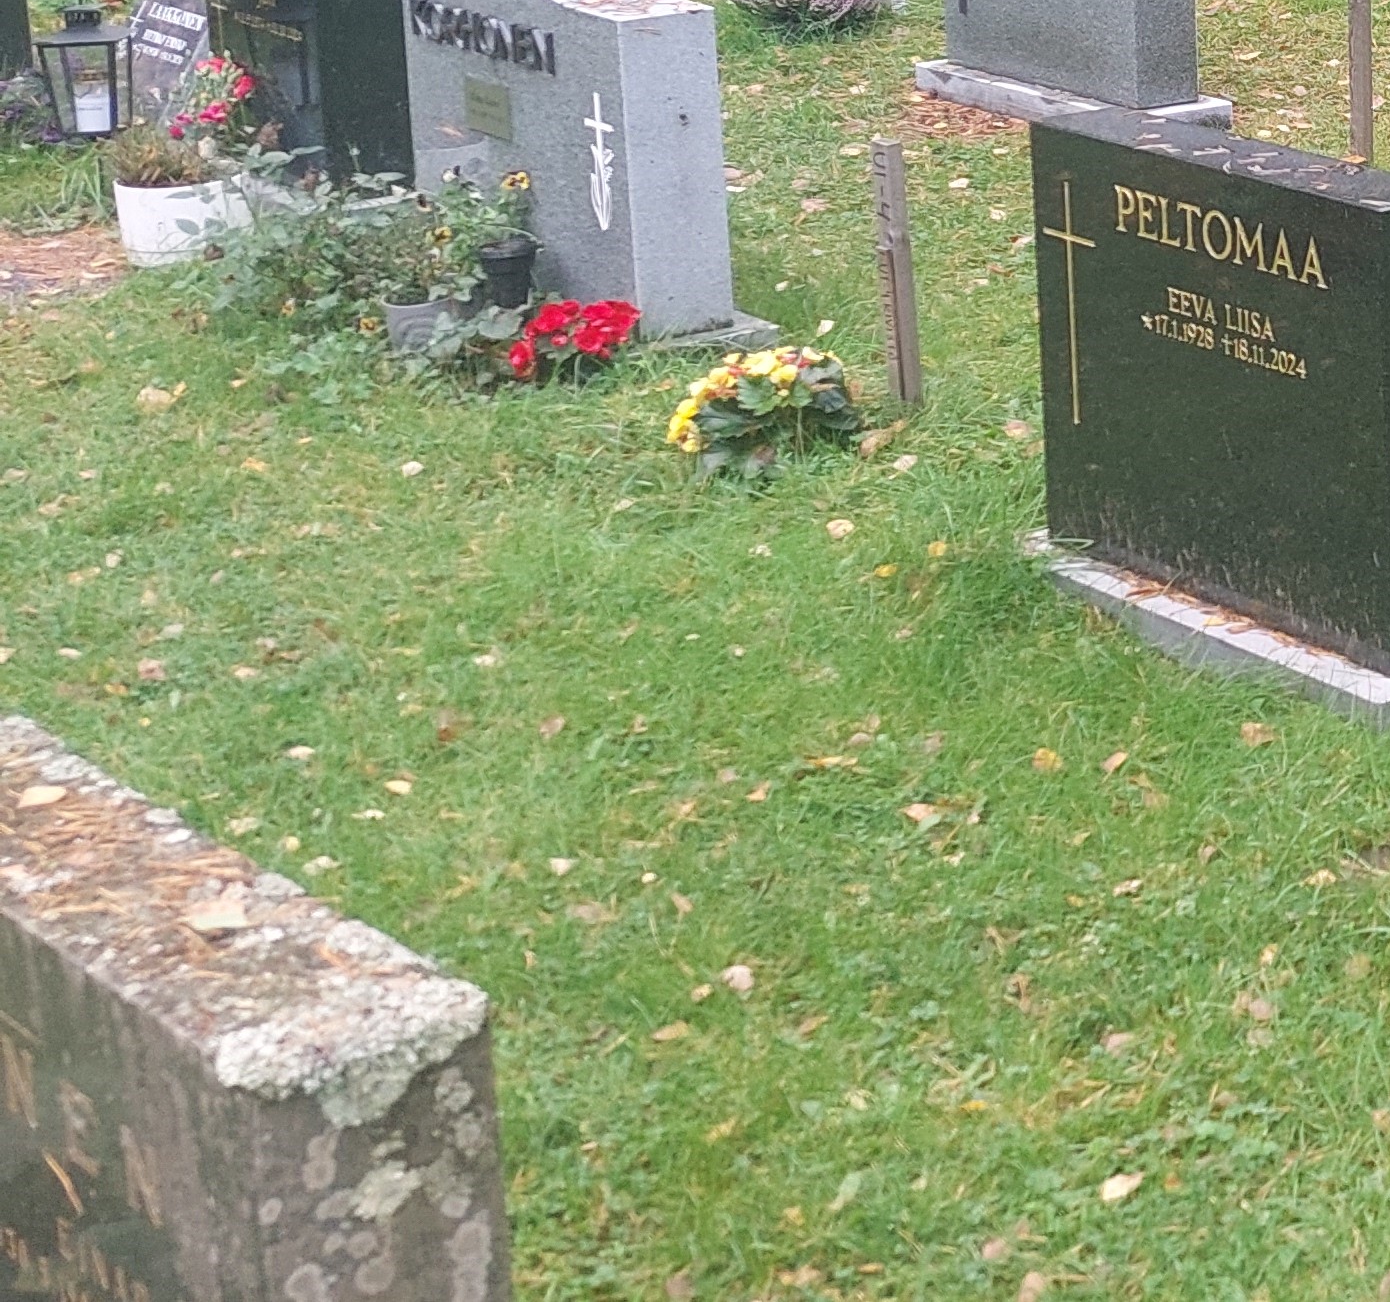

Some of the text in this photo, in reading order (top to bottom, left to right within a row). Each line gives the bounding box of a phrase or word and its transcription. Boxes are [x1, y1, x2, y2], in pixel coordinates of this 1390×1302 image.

[873, 151, 891, 222] U1-4
[1113, 184, 1330, 290] PELTOMAA
[1166, 287, 1276, 343] EEVA LIISA
